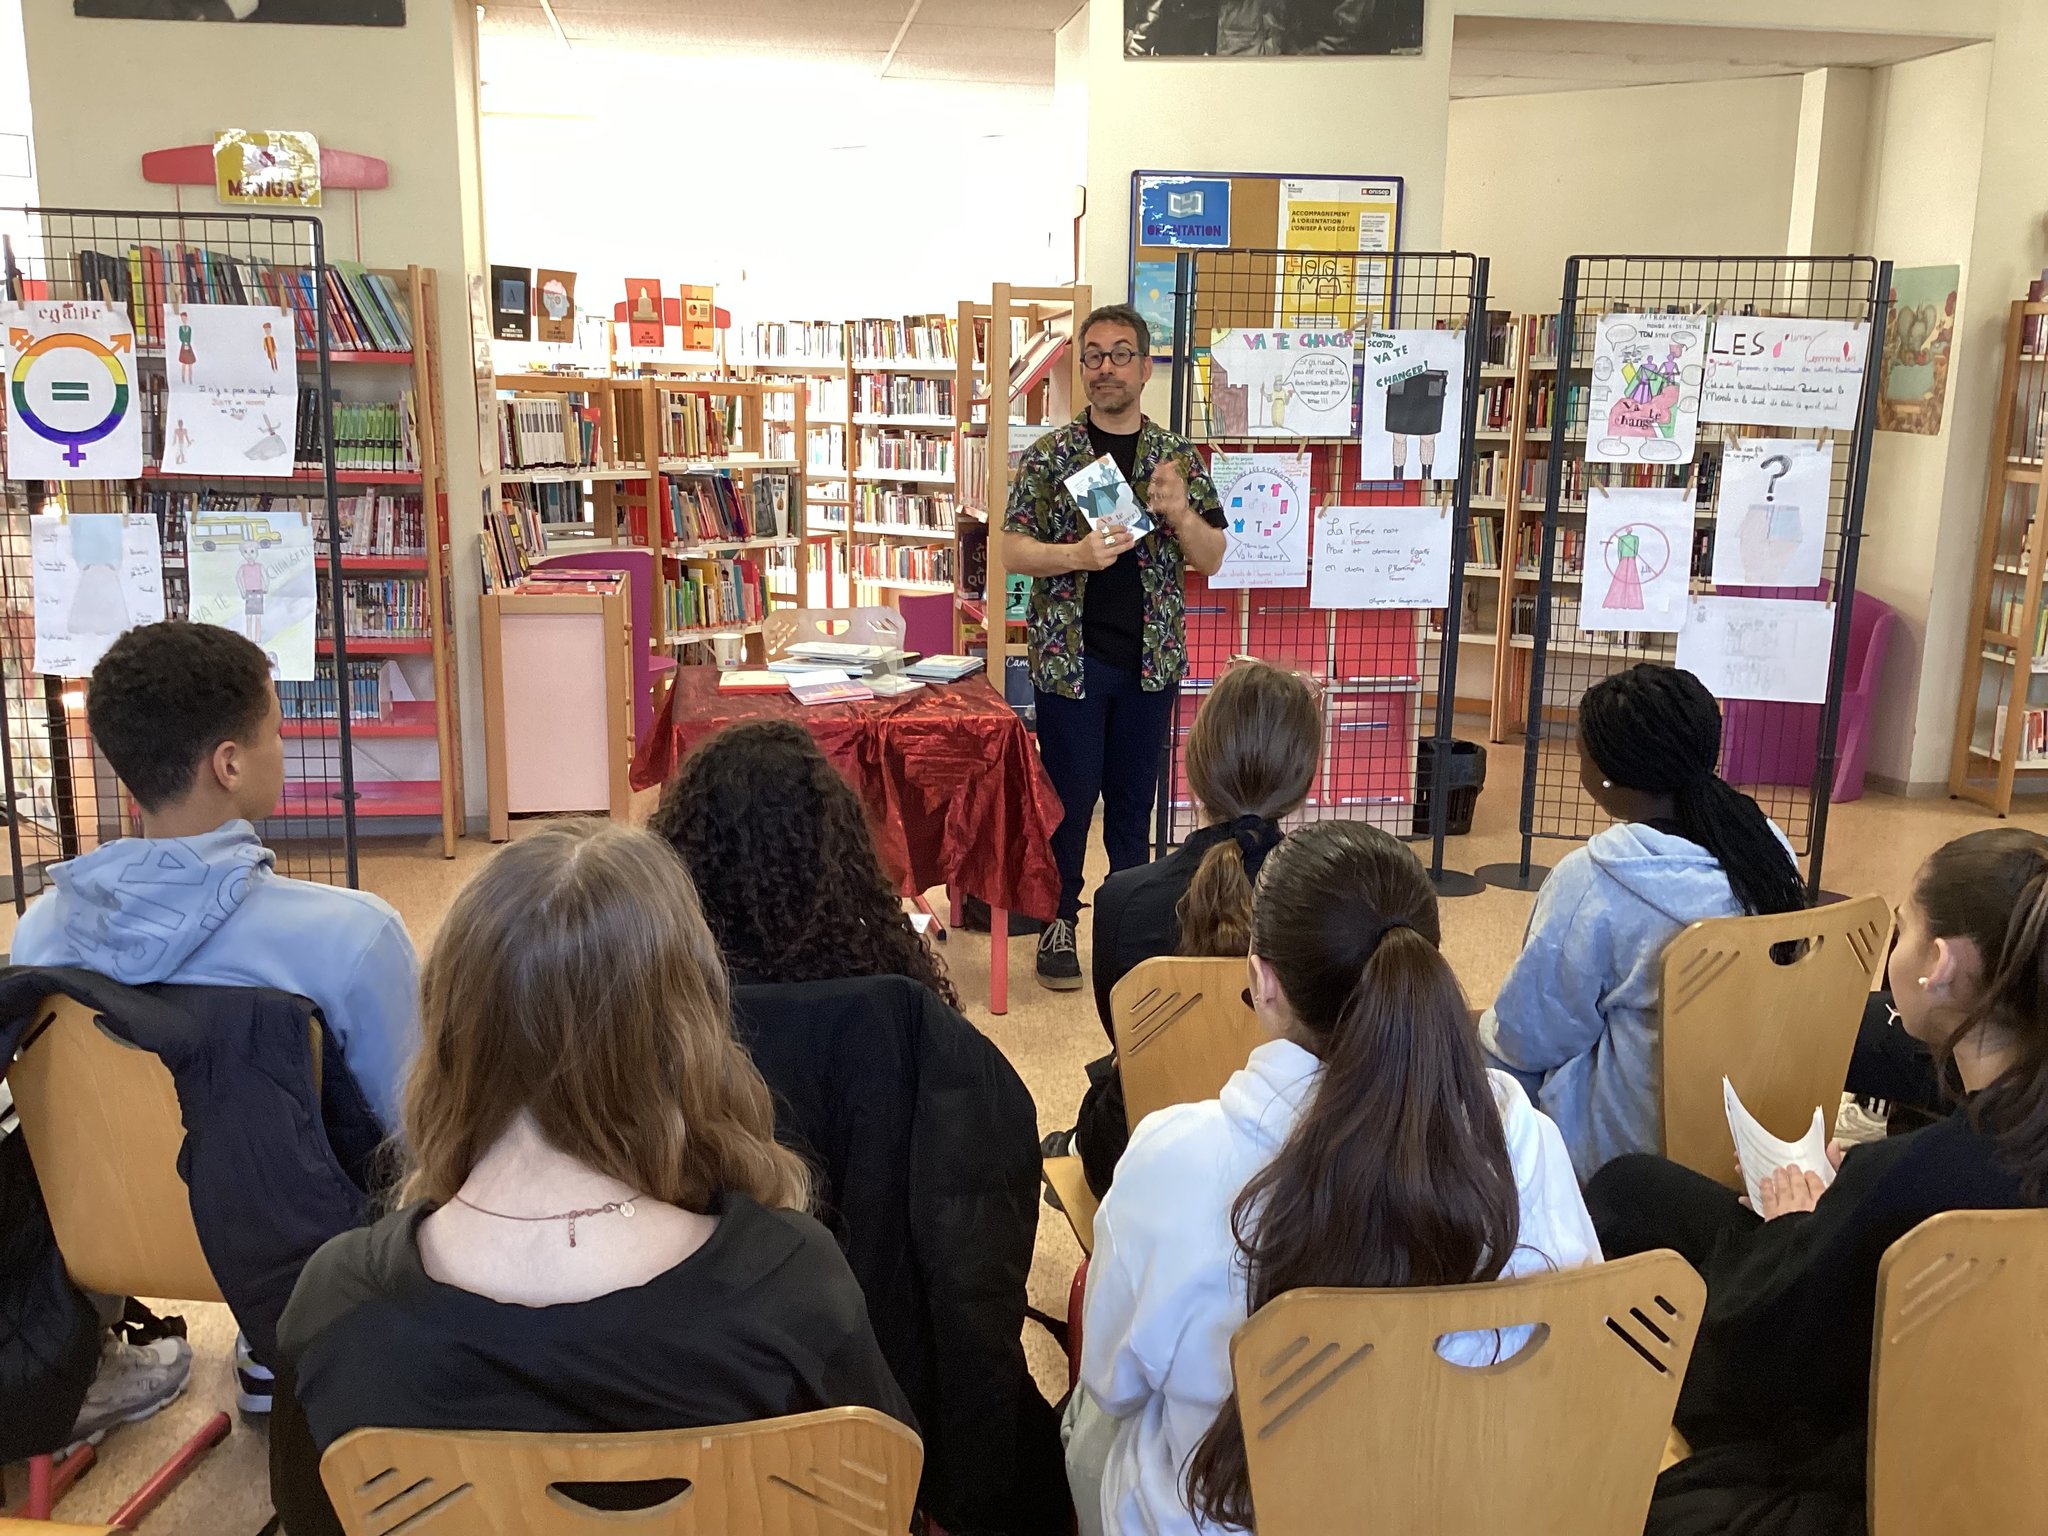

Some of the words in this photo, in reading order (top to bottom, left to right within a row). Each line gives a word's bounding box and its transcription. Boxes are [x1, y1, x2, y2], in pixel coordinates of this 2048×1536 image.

[1147, 225, 1222, 237] ORIENTATION
[1243, 333, 1266, 350] VA
[1273, 333, 1290, 350] TE
[1368, 340, 1394, 348] SCOTTO
[1712, 322, 1765, 356] LES
[1374, 352, 1391, 364] VA
[1393, 345, 1408, 357] TE
[1249, 466, 1260, 474] LES
[1326, 518, 1344, 536] La
[1006, 656, 1029, 668] Cam
